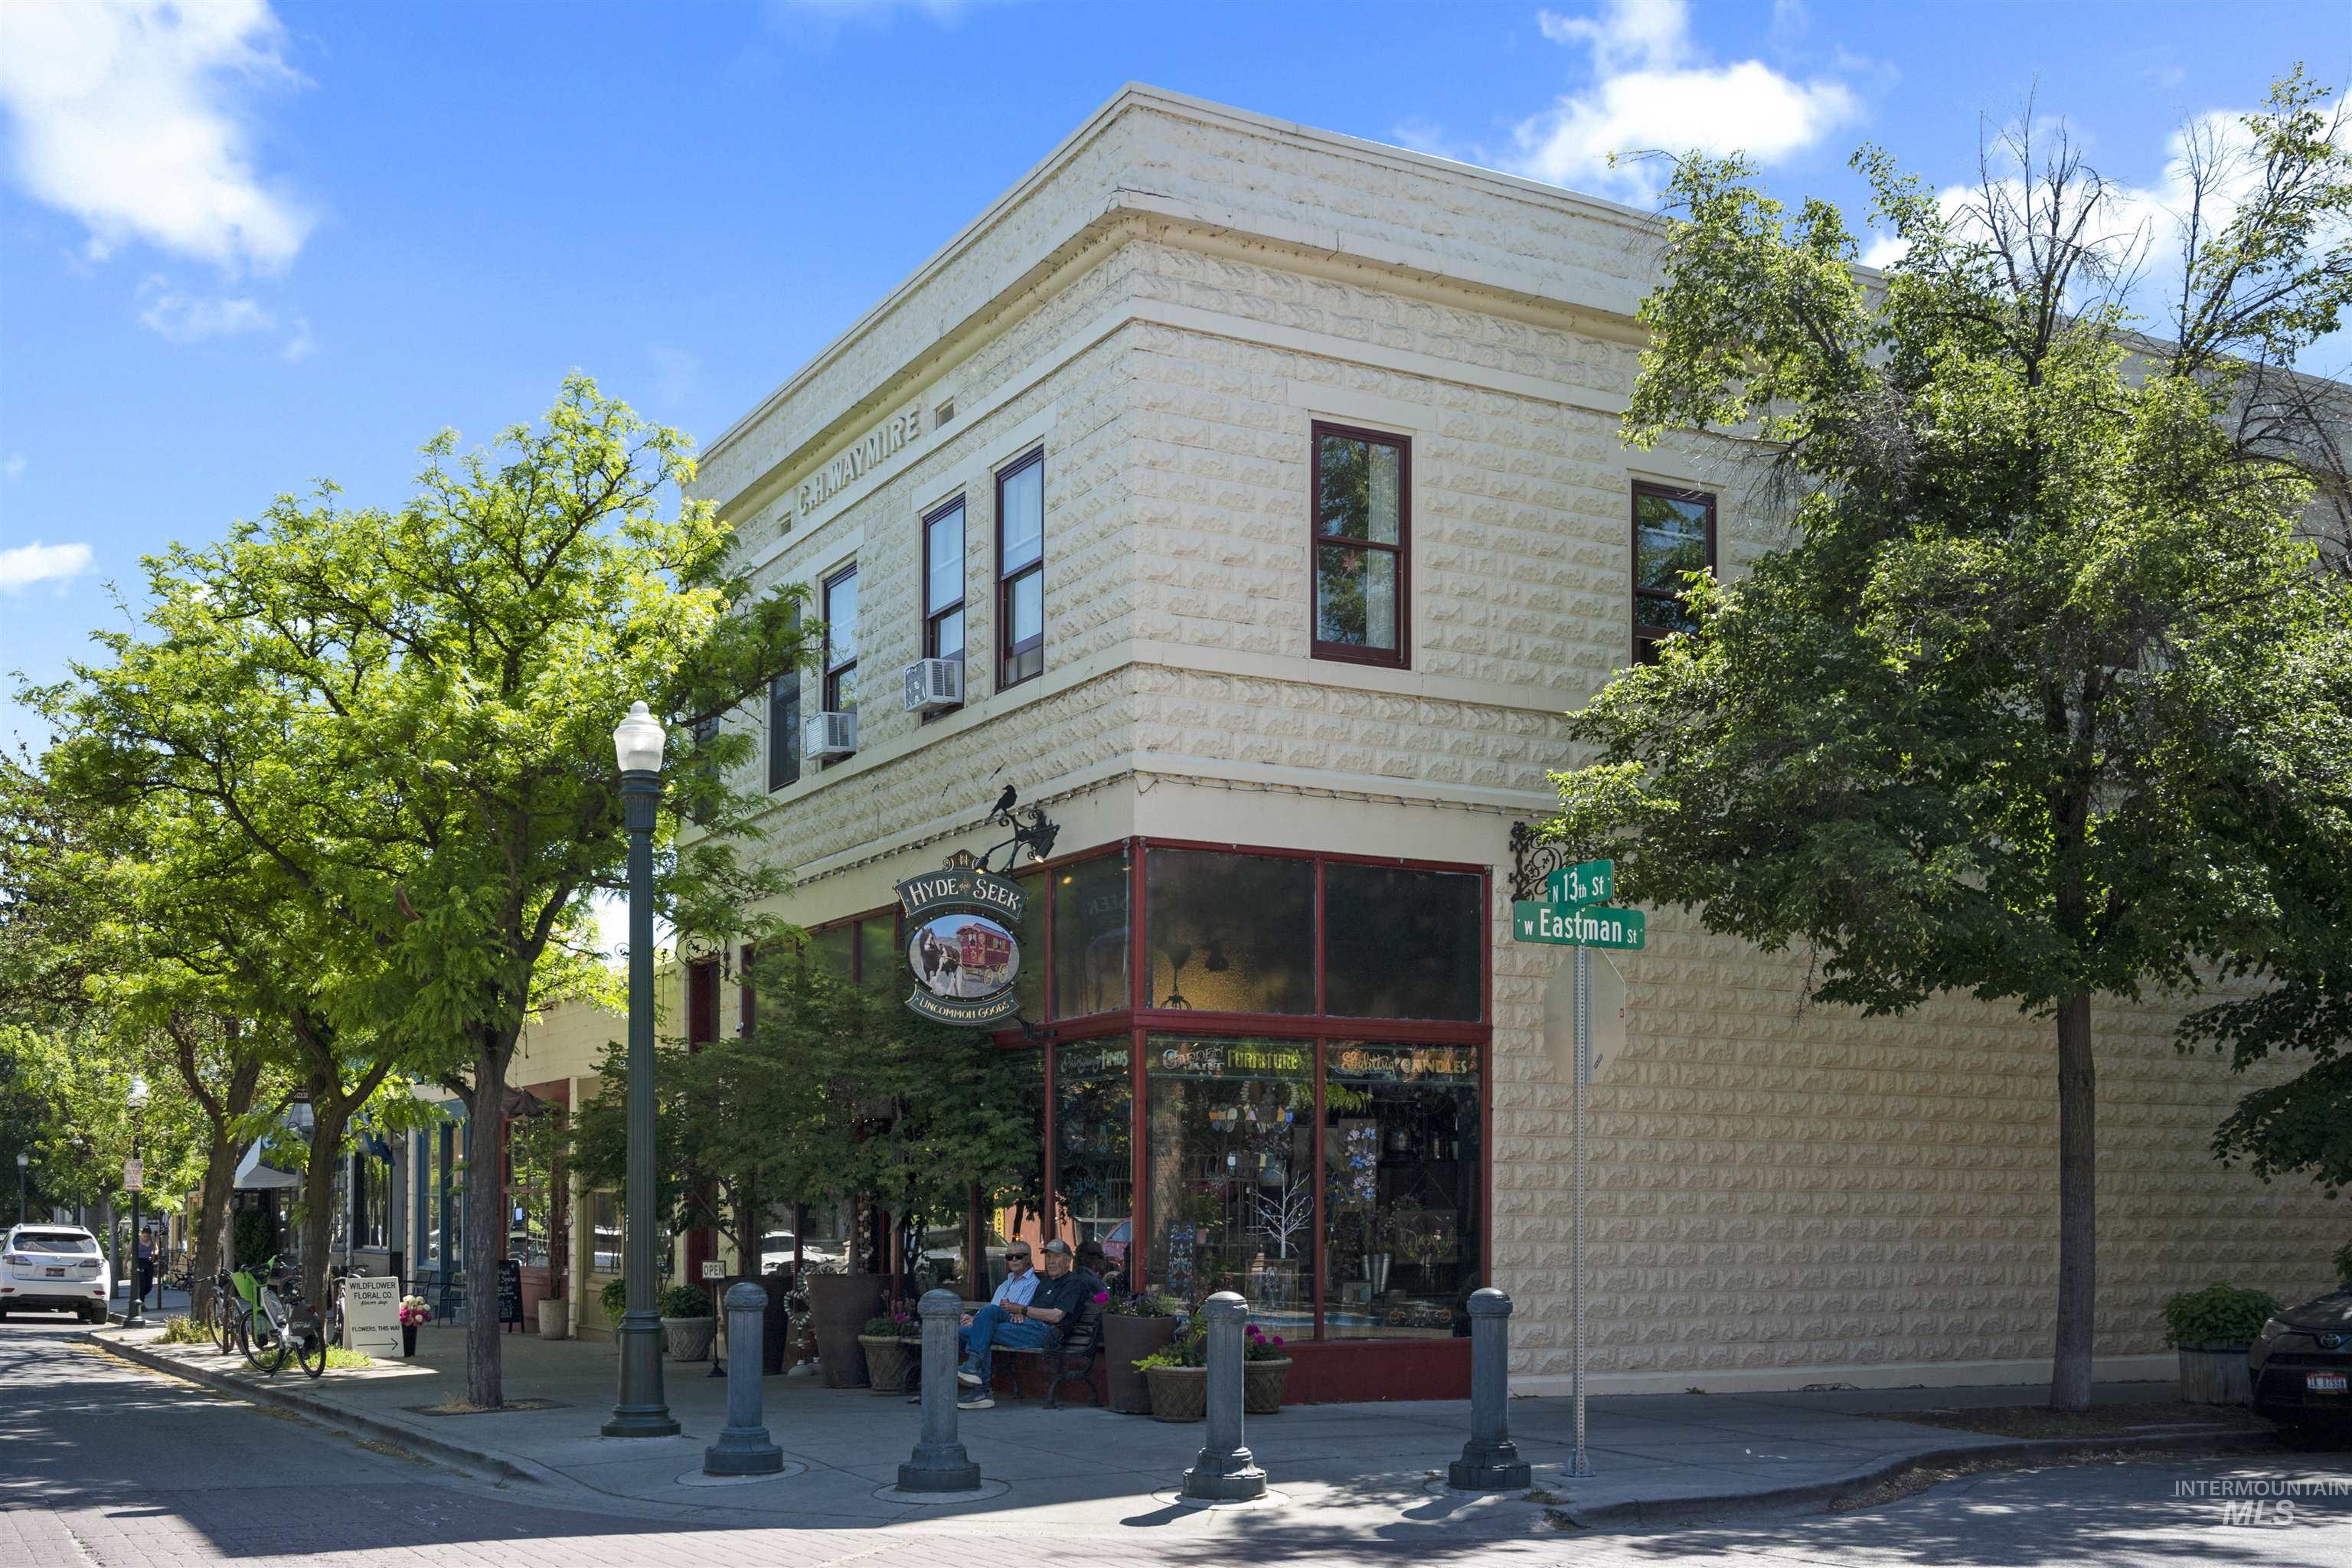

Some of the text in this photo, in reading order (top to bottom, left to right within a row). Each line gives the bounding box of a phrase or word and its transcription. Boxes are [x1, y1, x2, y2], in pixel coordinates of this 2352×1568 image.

[908, 878, 959, 906] HYDE
[972, 878, 1021, 911] SEEK
[1553, 871, 1605, 903] N 13th St
[1524, 908, 1638, 944] W Eastman St
[919, 997, 1010, 1019] UNCOMMON GOODS
[704, 1264, 724, 1276] OPEN
[349, 1282, 396, 1290] WILDFLOWER
